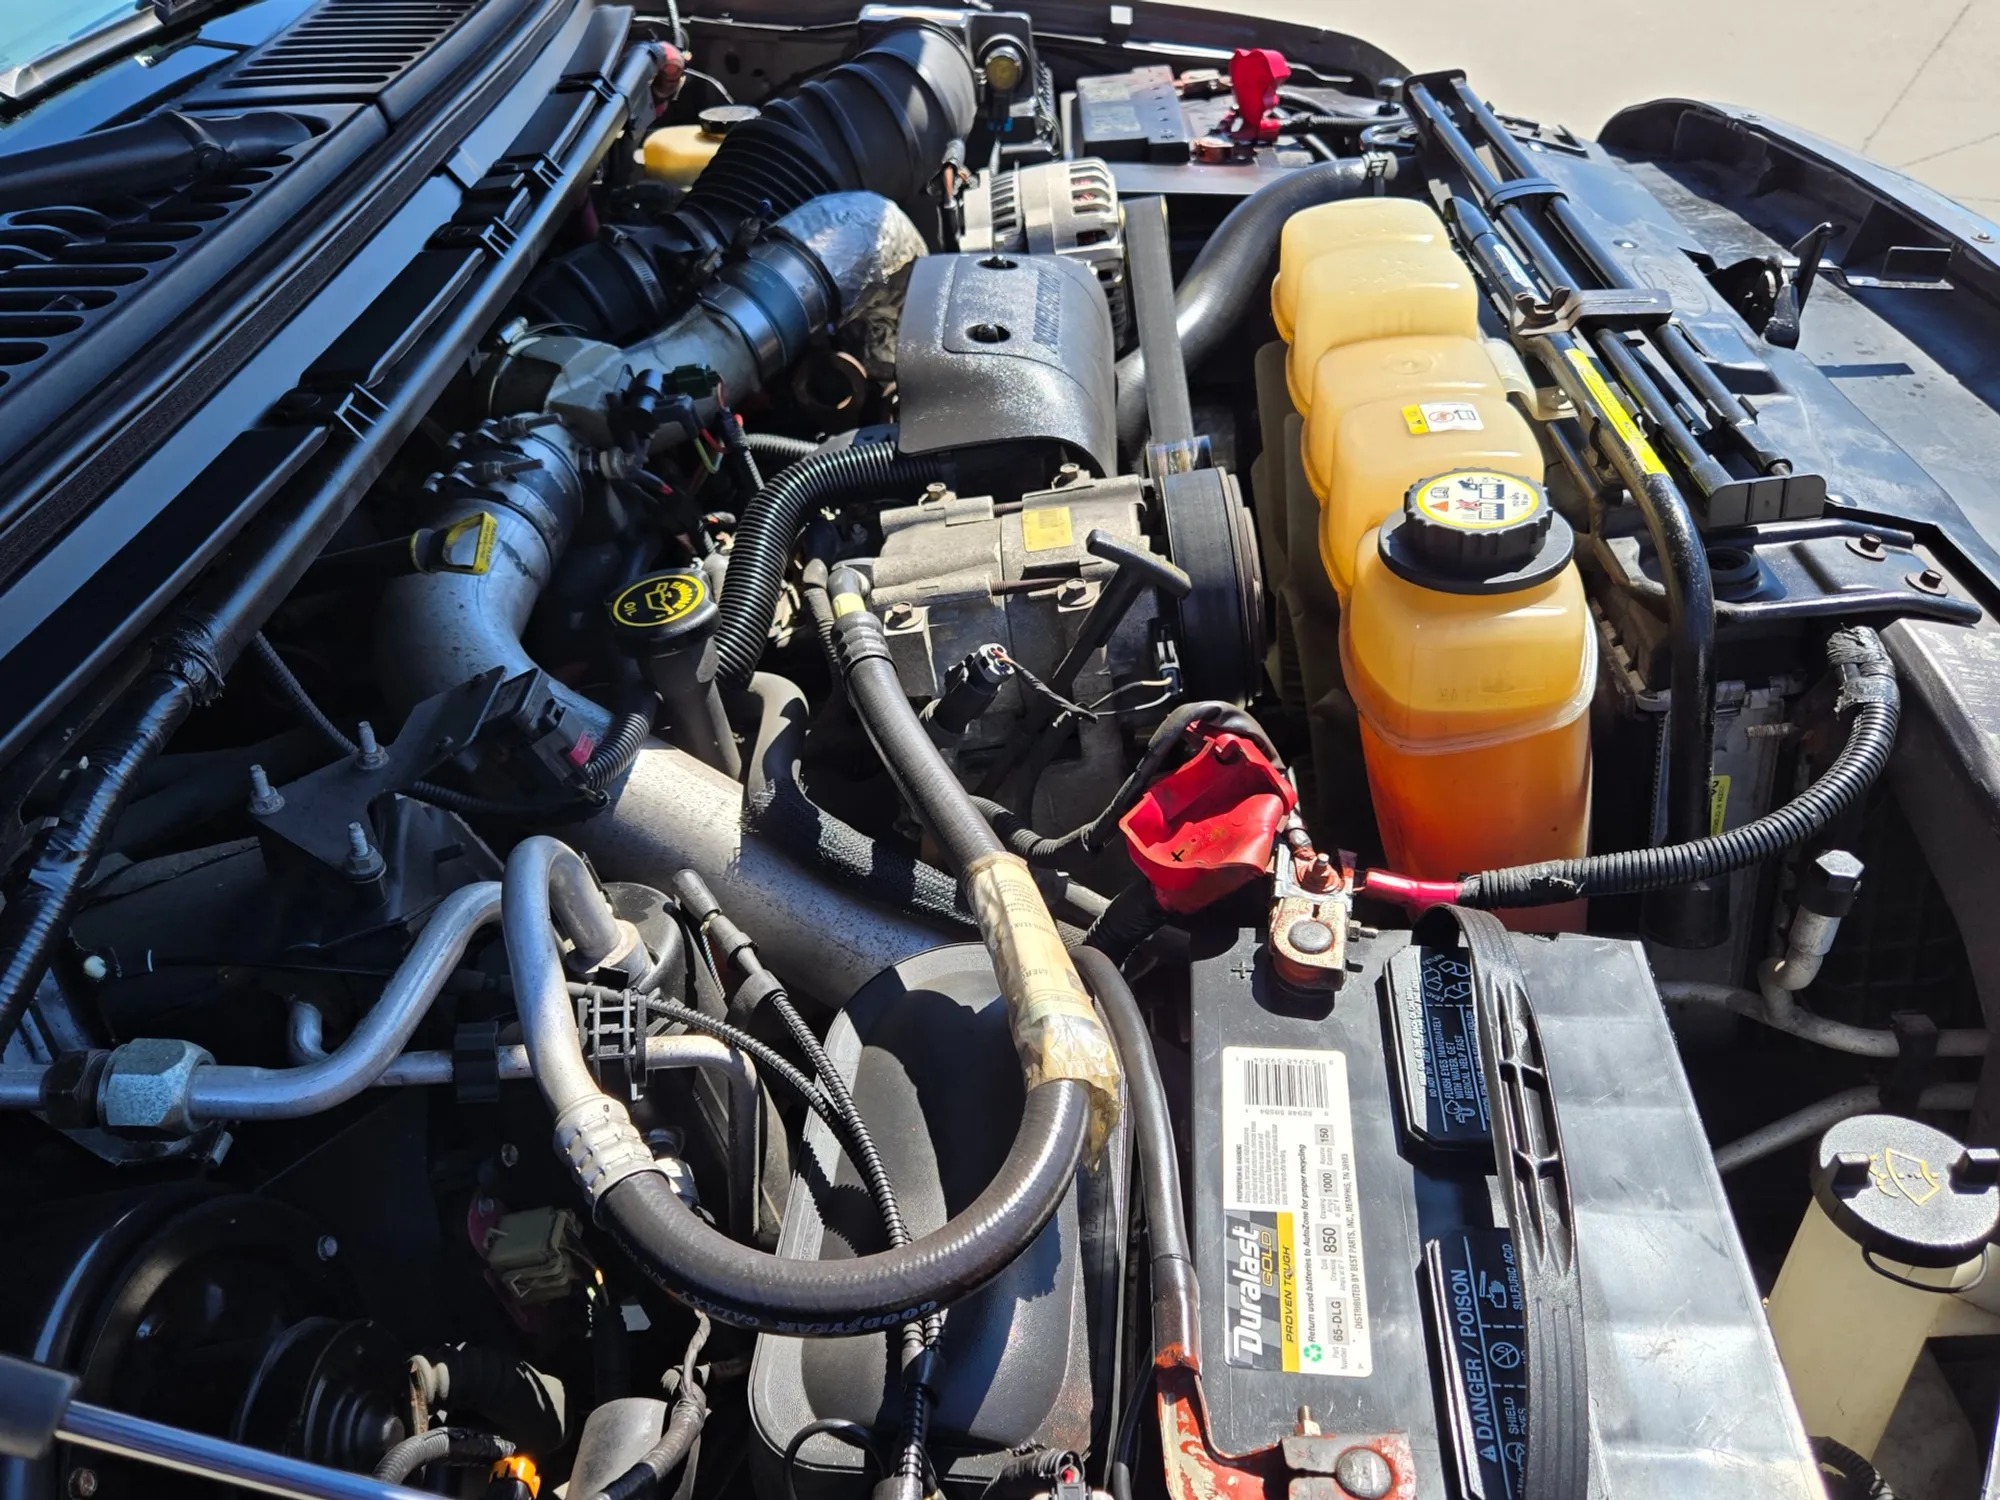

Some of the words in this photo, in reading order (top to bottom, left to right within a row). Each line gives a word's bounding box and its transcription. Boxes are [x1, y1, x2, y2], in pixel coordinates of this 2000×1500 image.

[624, 601, 637, 617] OIL
[1426, 991, 1445, 1003] LEAD
[1432, 1016, 1447, 1057] IMMEDIATELY
[1446, 1041, 1456, 1055] GET
[1454, 1035, 1465, 1051] FAST
[1440, 1059, 1450, 1076] EYES
[1458, 1052, 1469, 1069] HELP
[1428, 1076, 1436, 1088] NOT
[1429, 1088, 1437, 1098] DO
[1442, 1078, 1454, 1099] FLUSH
[1453, 1082, 1464, 1099] WITH
[1462, 1071, 1474, 1099] MEDICAL
[1319, 1128, 1330, 1143] 150
[1298, 1144, 1307, 1175] recycling
[1300, 1175, 1309, 1198] proper
[1322, 1172, 1333, 1193] 1000
[1342, 1171, 1350, 1181] TN
[1300, 1199, 1309, 1210] for
[1343, 1182, 1353, 1213] MEMPHIS,
[1301, 1211, 1310, 1247] AutoZone
[1322, 1227, 1338, 1254] 850
[1303, 1248, 1311, 1257] to
[1346, 1230, 1356, 1254] PARTS,
[1261, 1231, 1274, 1287] GOLD
[1348, 1254, 1359, 1272] BEST
[1501, 1243, 1514, 1265] ACID
[1282, 1247, 1292, 1286] TOUGH
[1304, 1258, 1313, 1292] batteries
[1351, 1273, 1359, 1283] BY
[1232, 1226, 1263, 1358] Duralast
[1507, 1267, 1523, 1311] SULFURIC
[679, 1289, 761, 1328] GALAXY
[1306, 1293, 1314, 1313] used
[1351, 1284, 1363, 1330] DISTRIBUTED
[1450, 1269, 1477, 1338] POISON
[778, 1300, 938, 1335] GOODYEAR
[1284, 1290, 1294, 1344] PROVEN
[1307, 1314, 1316, 1343] Return
[1331, 1301, 1344, 1342] 65-DLG
[1462, 1341, 1480, 1355] /
[1464, 1358, 1494, 1440] DANGER
[1503, 1397, 1520, 1435] SHIELD
